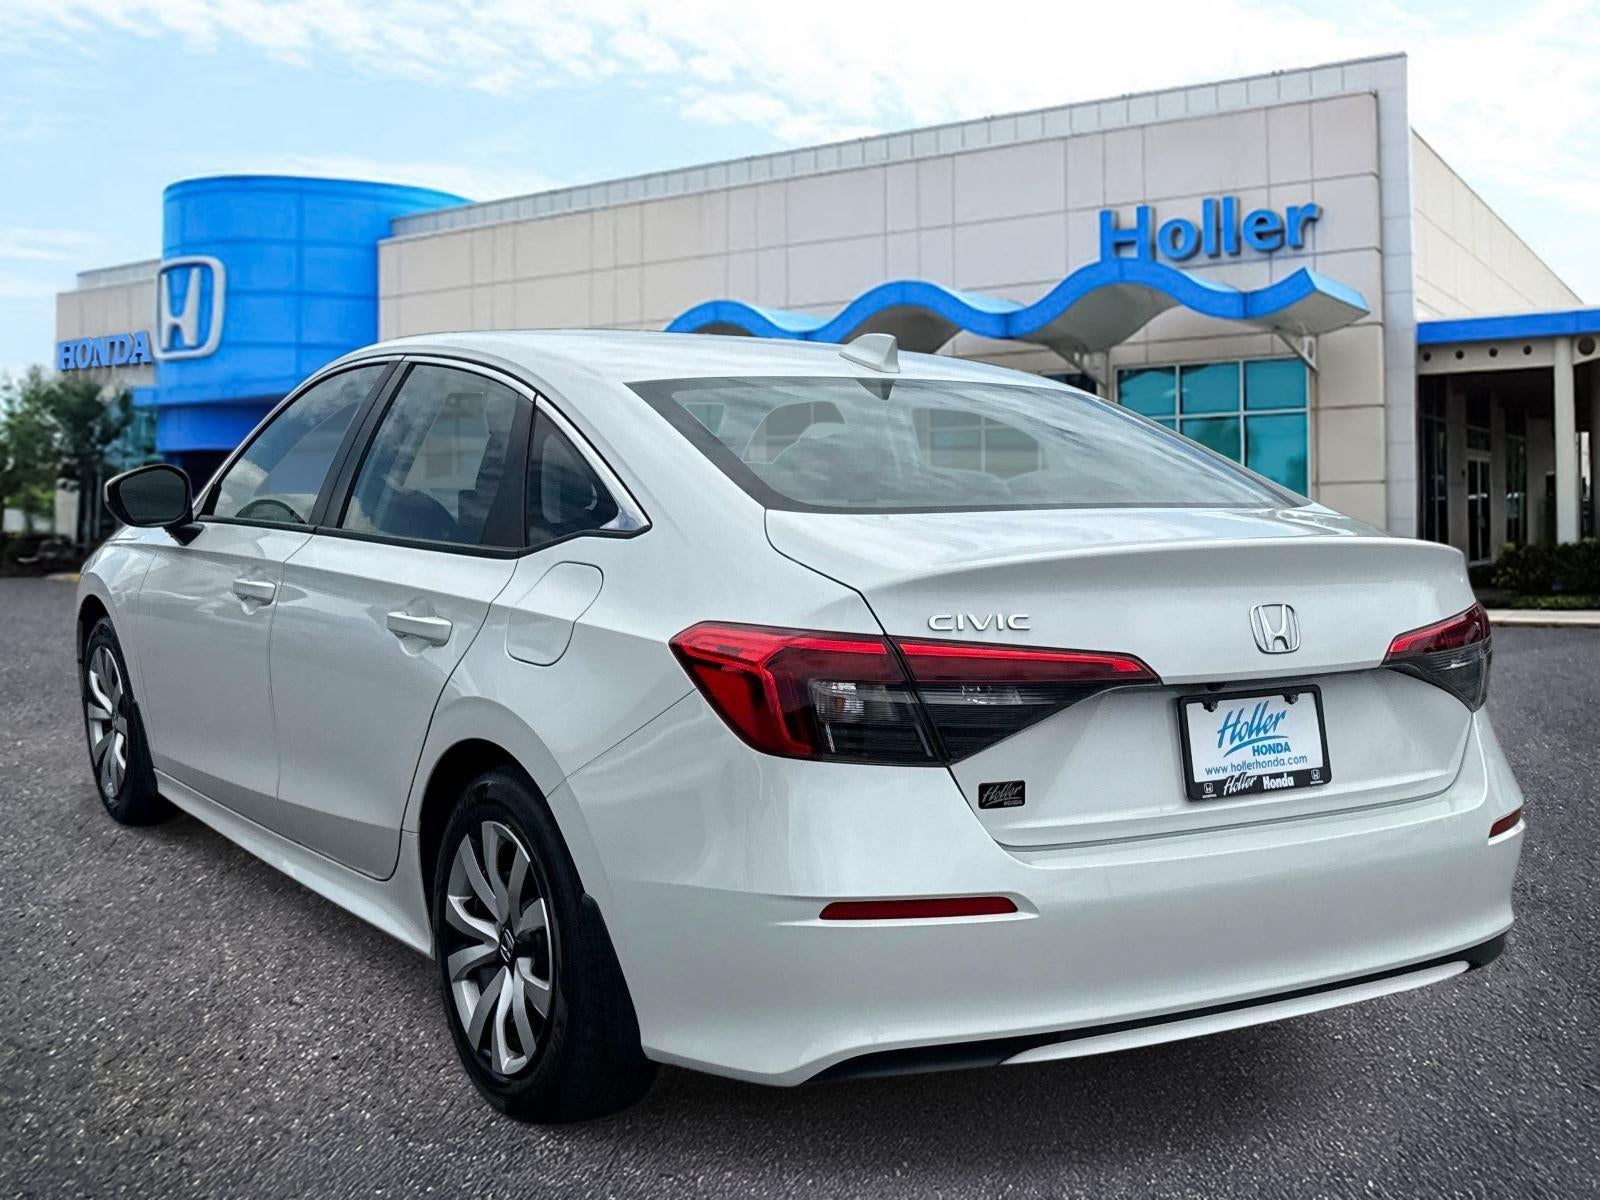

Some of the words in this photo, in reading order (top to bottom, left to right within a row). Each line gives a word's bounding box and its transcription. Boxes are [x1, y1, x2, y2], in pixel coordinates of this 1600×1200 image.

[1099, 196, 1322, 263] Holler
[57, 331, 152, 371] HONDA
[927, 612, 1031, 631] CIVIC
[1217, 700, 1287, 748] Holler
[1252, 741, 1291, 757] HONDA
[1223, 772, 1257, 796] Holler
[1262, 772, 1294, 790] Honda
